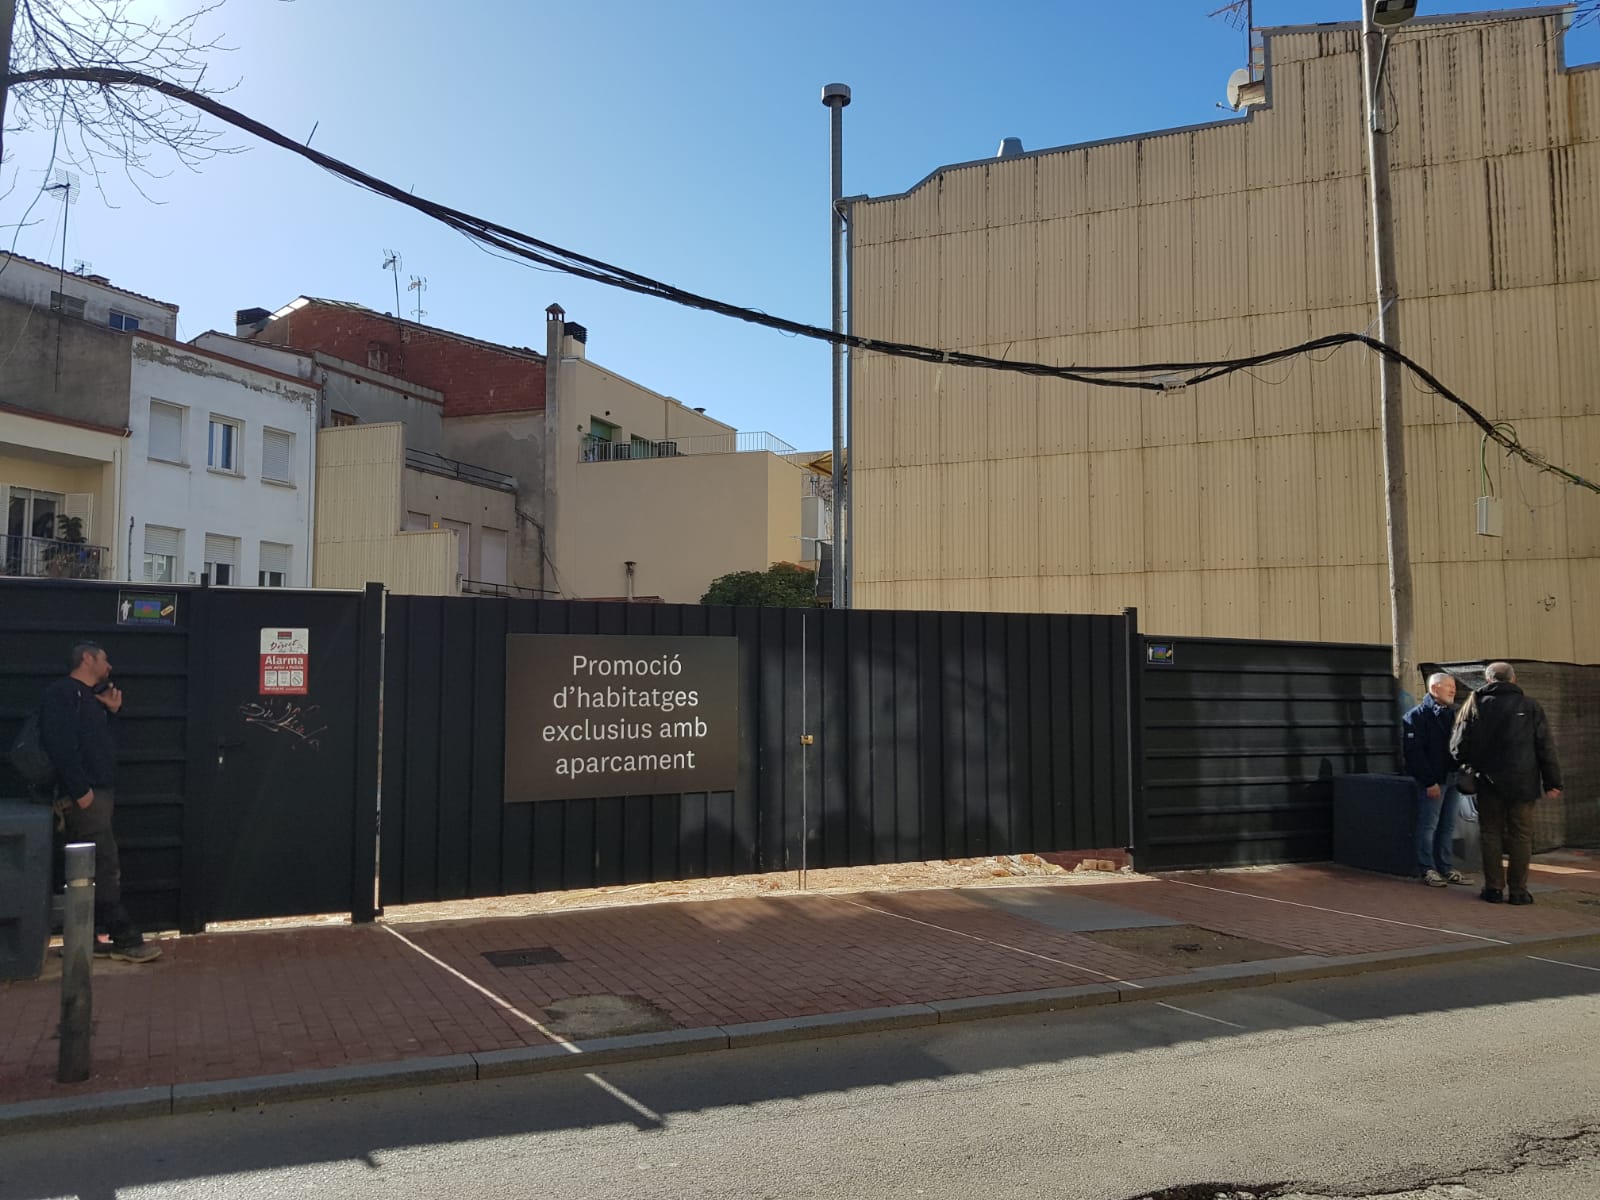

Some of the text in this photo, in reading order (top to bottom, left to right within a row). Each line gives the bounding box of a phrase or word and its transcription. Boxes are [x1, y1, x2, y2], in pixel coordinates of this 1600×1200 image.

[264, 655, 304, 665] Alarma
[573, 654, 682, 676] Promoció
[542, 716, 708, 742] exclusius amb
[555, 750, 696, 780] aparcament
